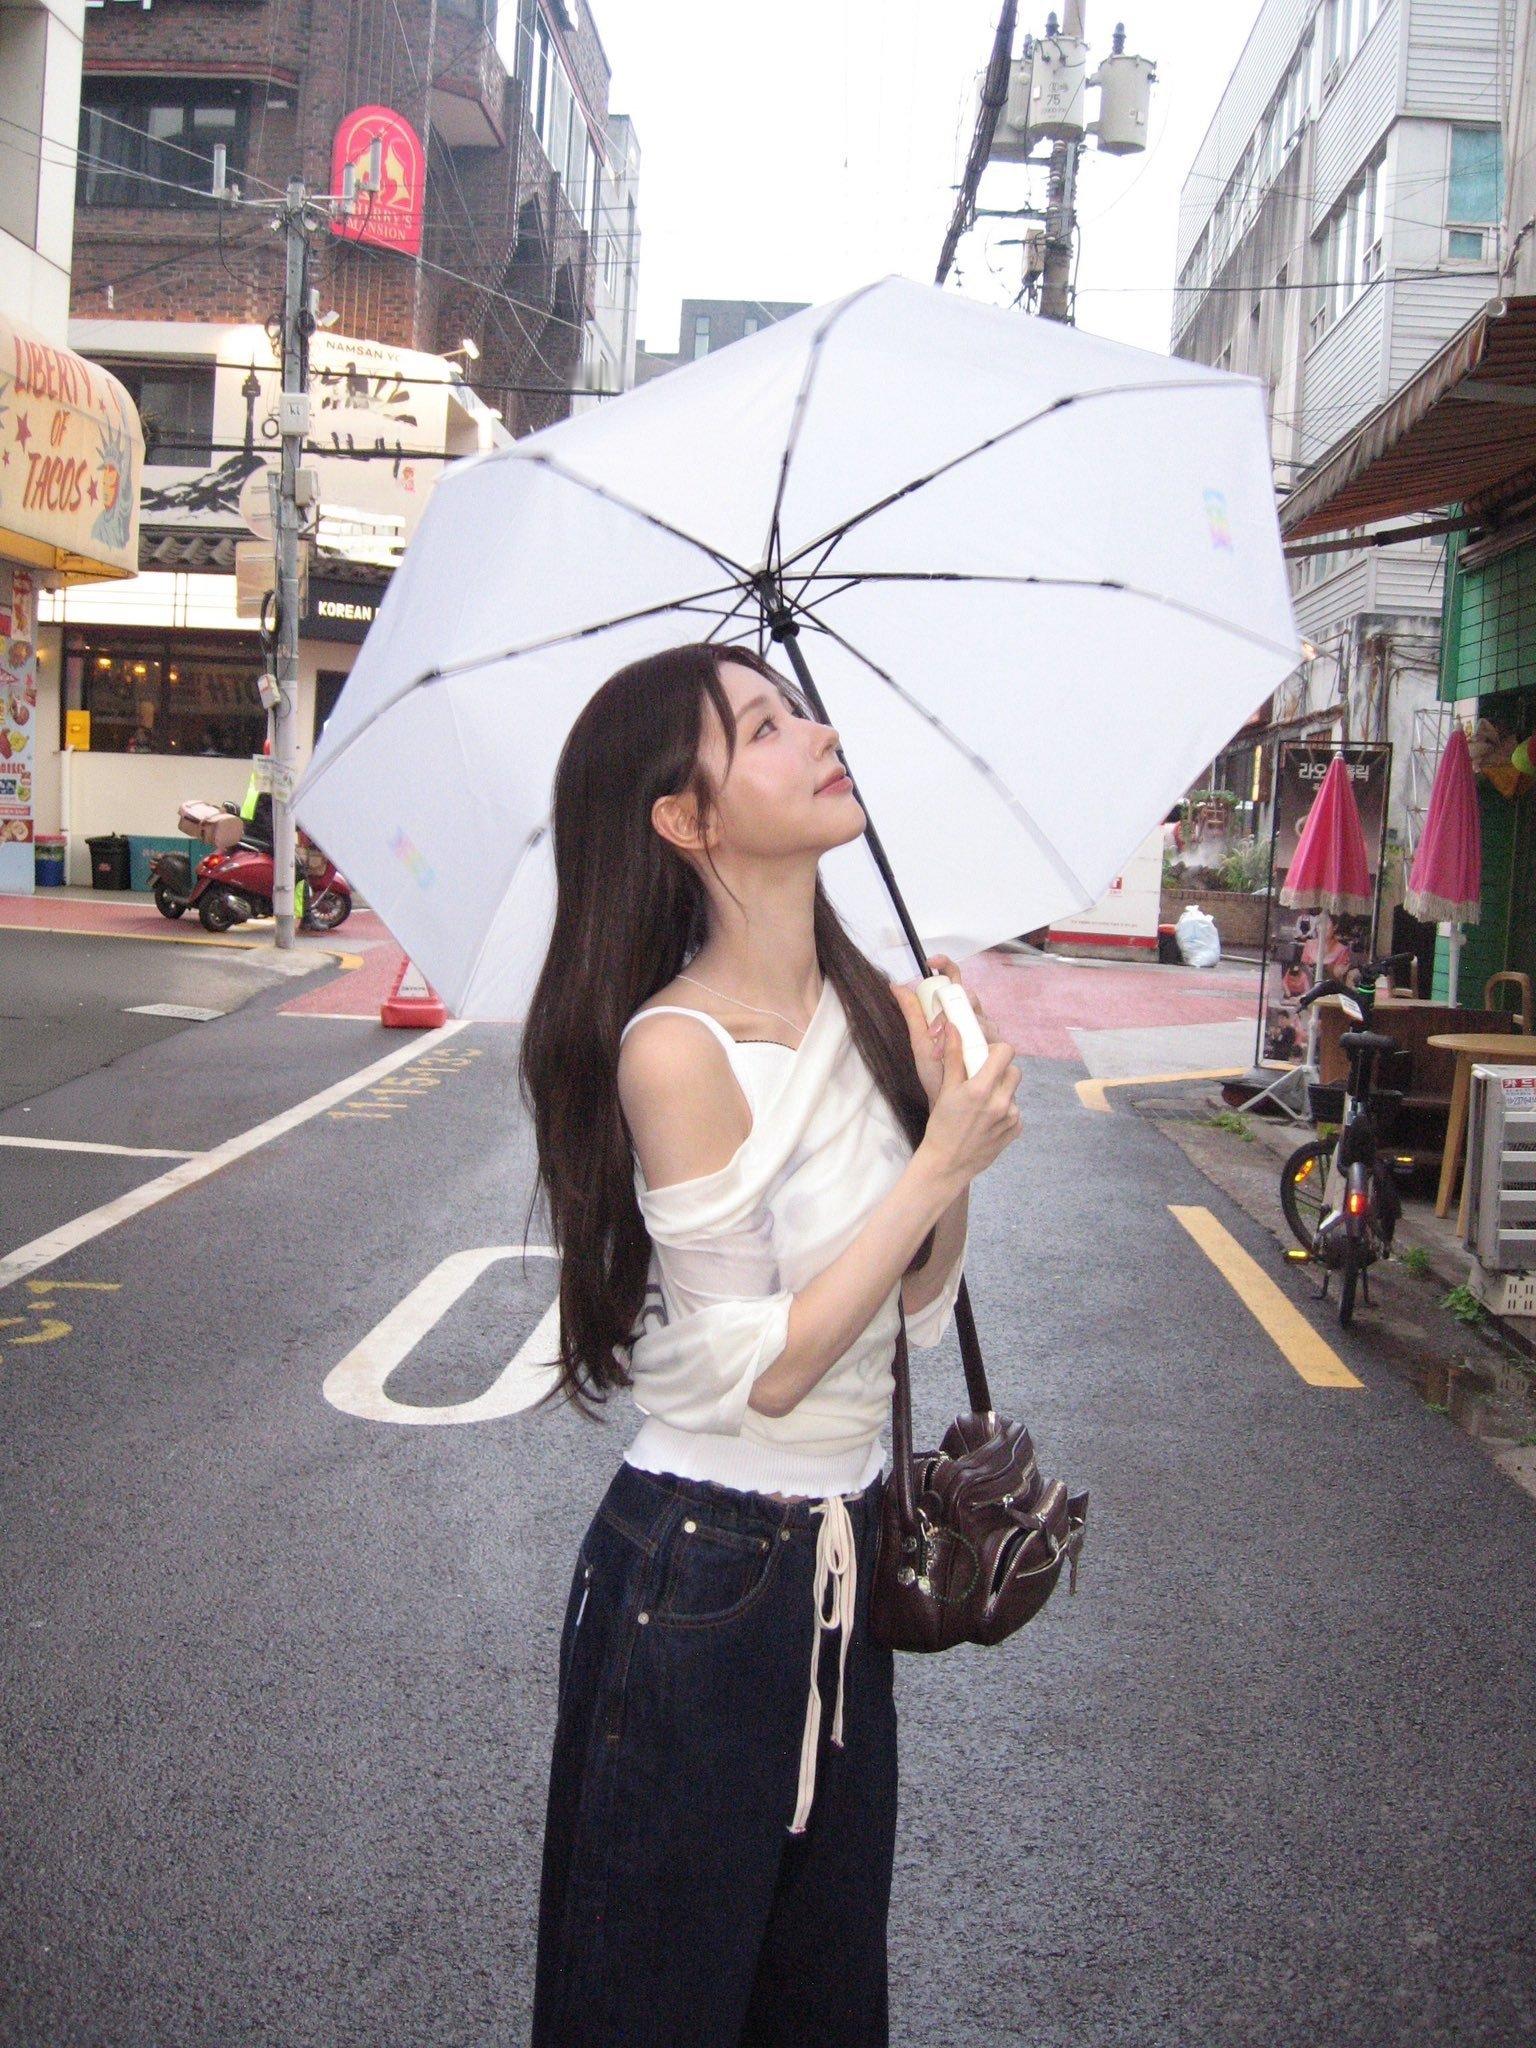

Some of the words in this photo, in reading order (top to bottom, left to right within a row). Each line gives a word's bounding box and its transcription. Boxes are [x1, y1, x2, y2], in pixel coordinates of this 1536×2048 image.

[325, 340, 384, 361] NAMSAN
[13, 335, 92, 409] LIBERTY
[49, 408, 71, 448] OF
[22, 450, 88, 512] TACOS
[318, 600, 373, 621] KOREAN
